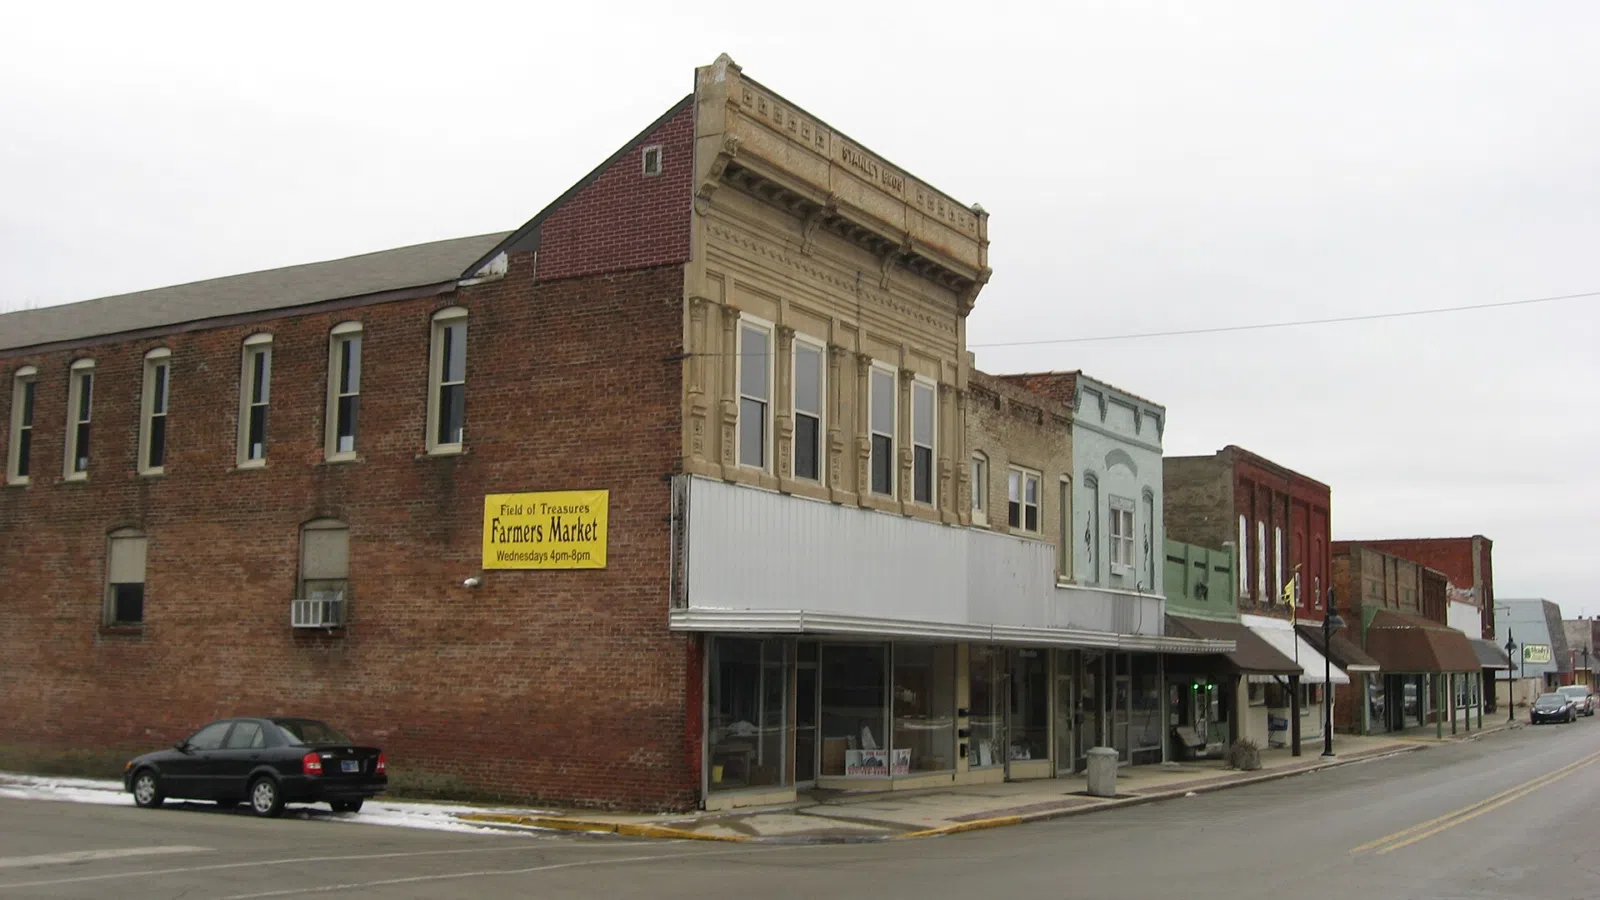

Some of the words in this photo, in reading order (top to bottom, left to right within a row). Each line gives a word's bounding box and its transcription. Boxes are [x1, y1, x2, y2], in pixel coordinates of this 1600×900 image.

[842, 146, 878, 180] STANLEY
[500, 504, 523, 516] Field
[526, 503, 536, 514] of
[540, 502, 590, 514] Treasures
[491, 517, 543, 543] Farmers
[548, 516, 598, 542] Market
[496, 550, 548, 564] Wednesdays
[550, 549, 591, 563] 4pm-8pm
